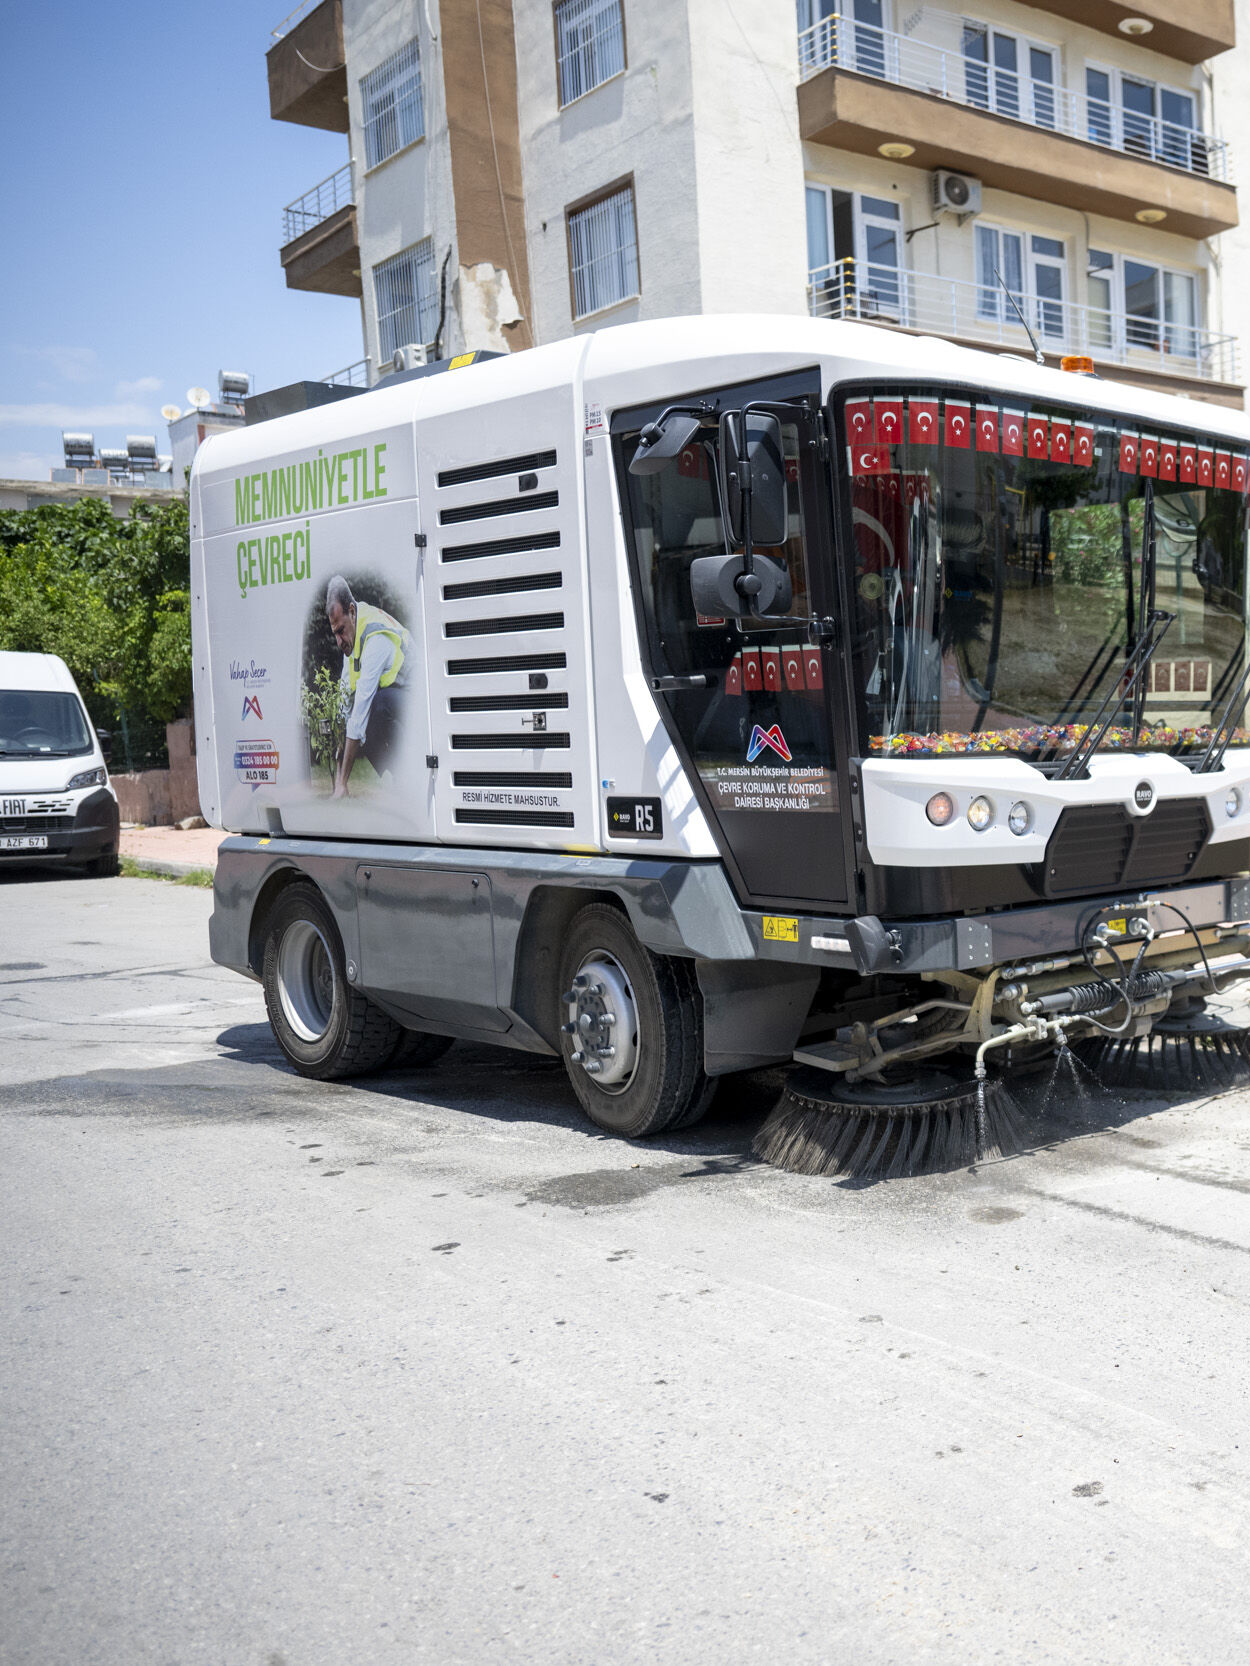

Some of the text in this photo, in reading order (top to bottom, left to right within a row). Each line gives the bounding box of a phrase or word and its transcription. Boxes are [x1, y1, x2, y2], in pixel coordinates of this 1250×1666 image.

[235, 443, 388, 526] MEMNUNİYETLE
[236, 520, 311, 599] ÇEVRECİ
[246, 771, 269, 780] ALO 185
[717, 766, 824, 778] T.C. MERSİN BÜYÜKŞEHİR BELEDİYESİ
[718, 782, 826, 795] ÇEVRE KORUMA VE KONTROL
[2, 799, 27, 815] FIAT
[462, 791, 561, 807] RESMİ HİZMETE MAHSUSTUR.
[734, 795, 810, 811] DAİRESİ BAŞKANLIĞI
[634, 804, 654, 832] R5
[6, 837, 46, 848] AZF 671
